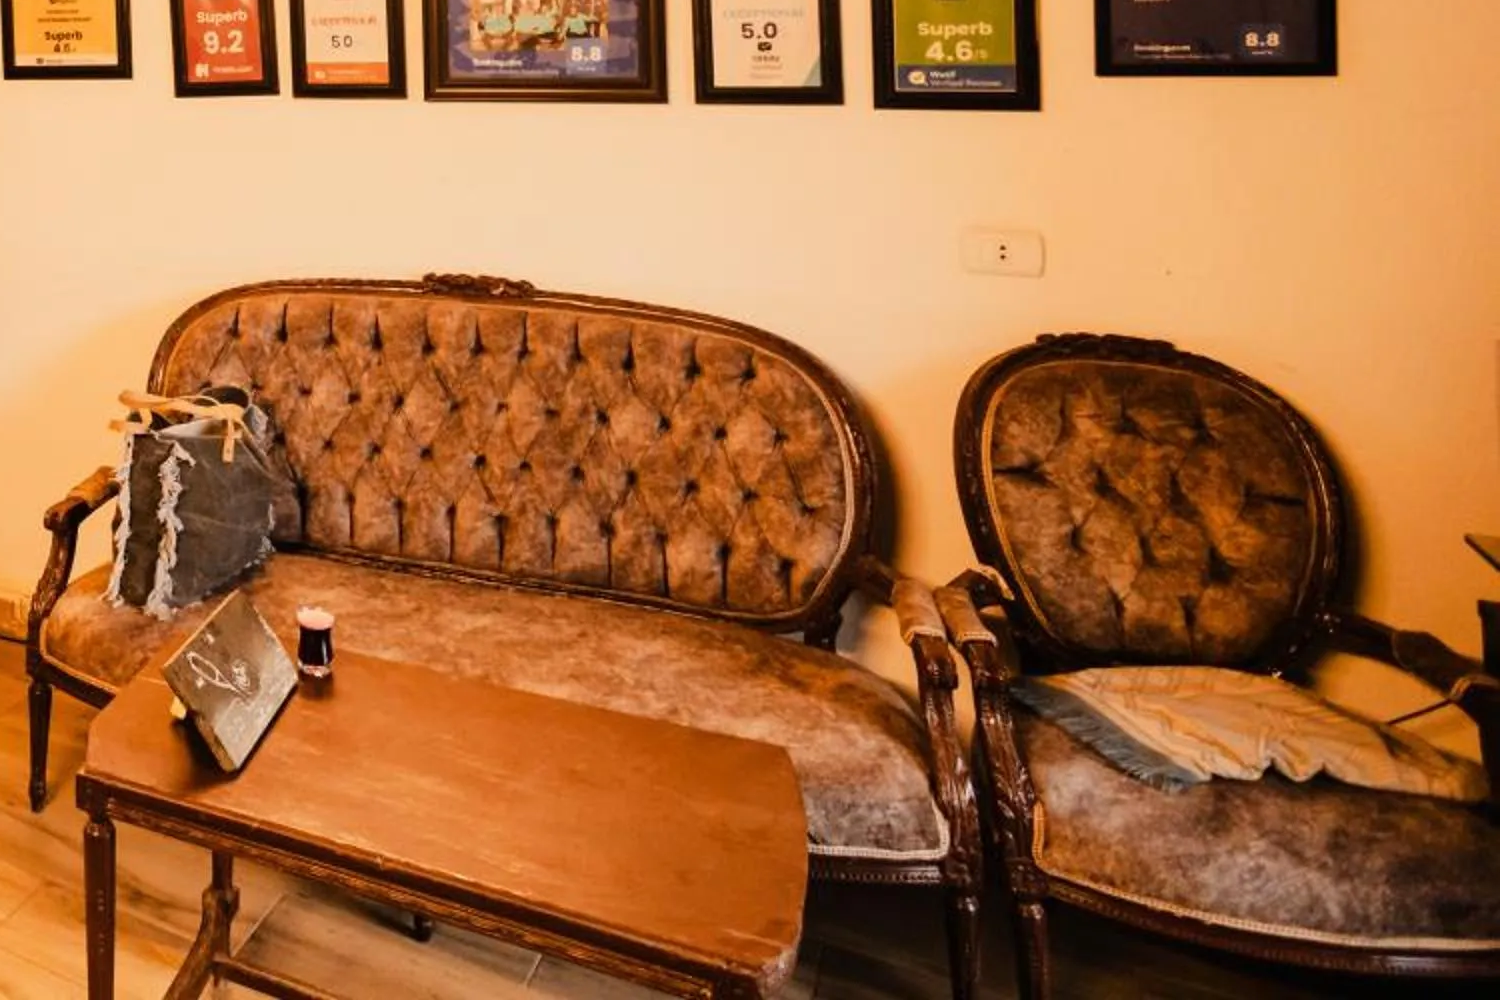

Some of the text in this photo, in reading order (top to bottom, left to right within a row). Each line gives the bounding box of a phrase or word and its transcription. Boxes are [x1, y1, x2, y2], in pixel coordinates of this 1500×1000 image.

[196, 9, 249, 27] Superb
[44, 31, 83, 43] Superb
[740, 22, 778, 39] 5.0
[917, 21, 994, 40] Superb
[203, 29, 245, 55] 9.2
[1244, 32, 1280, 47] 8.8
[571, 46, 602, 62] 8.8
